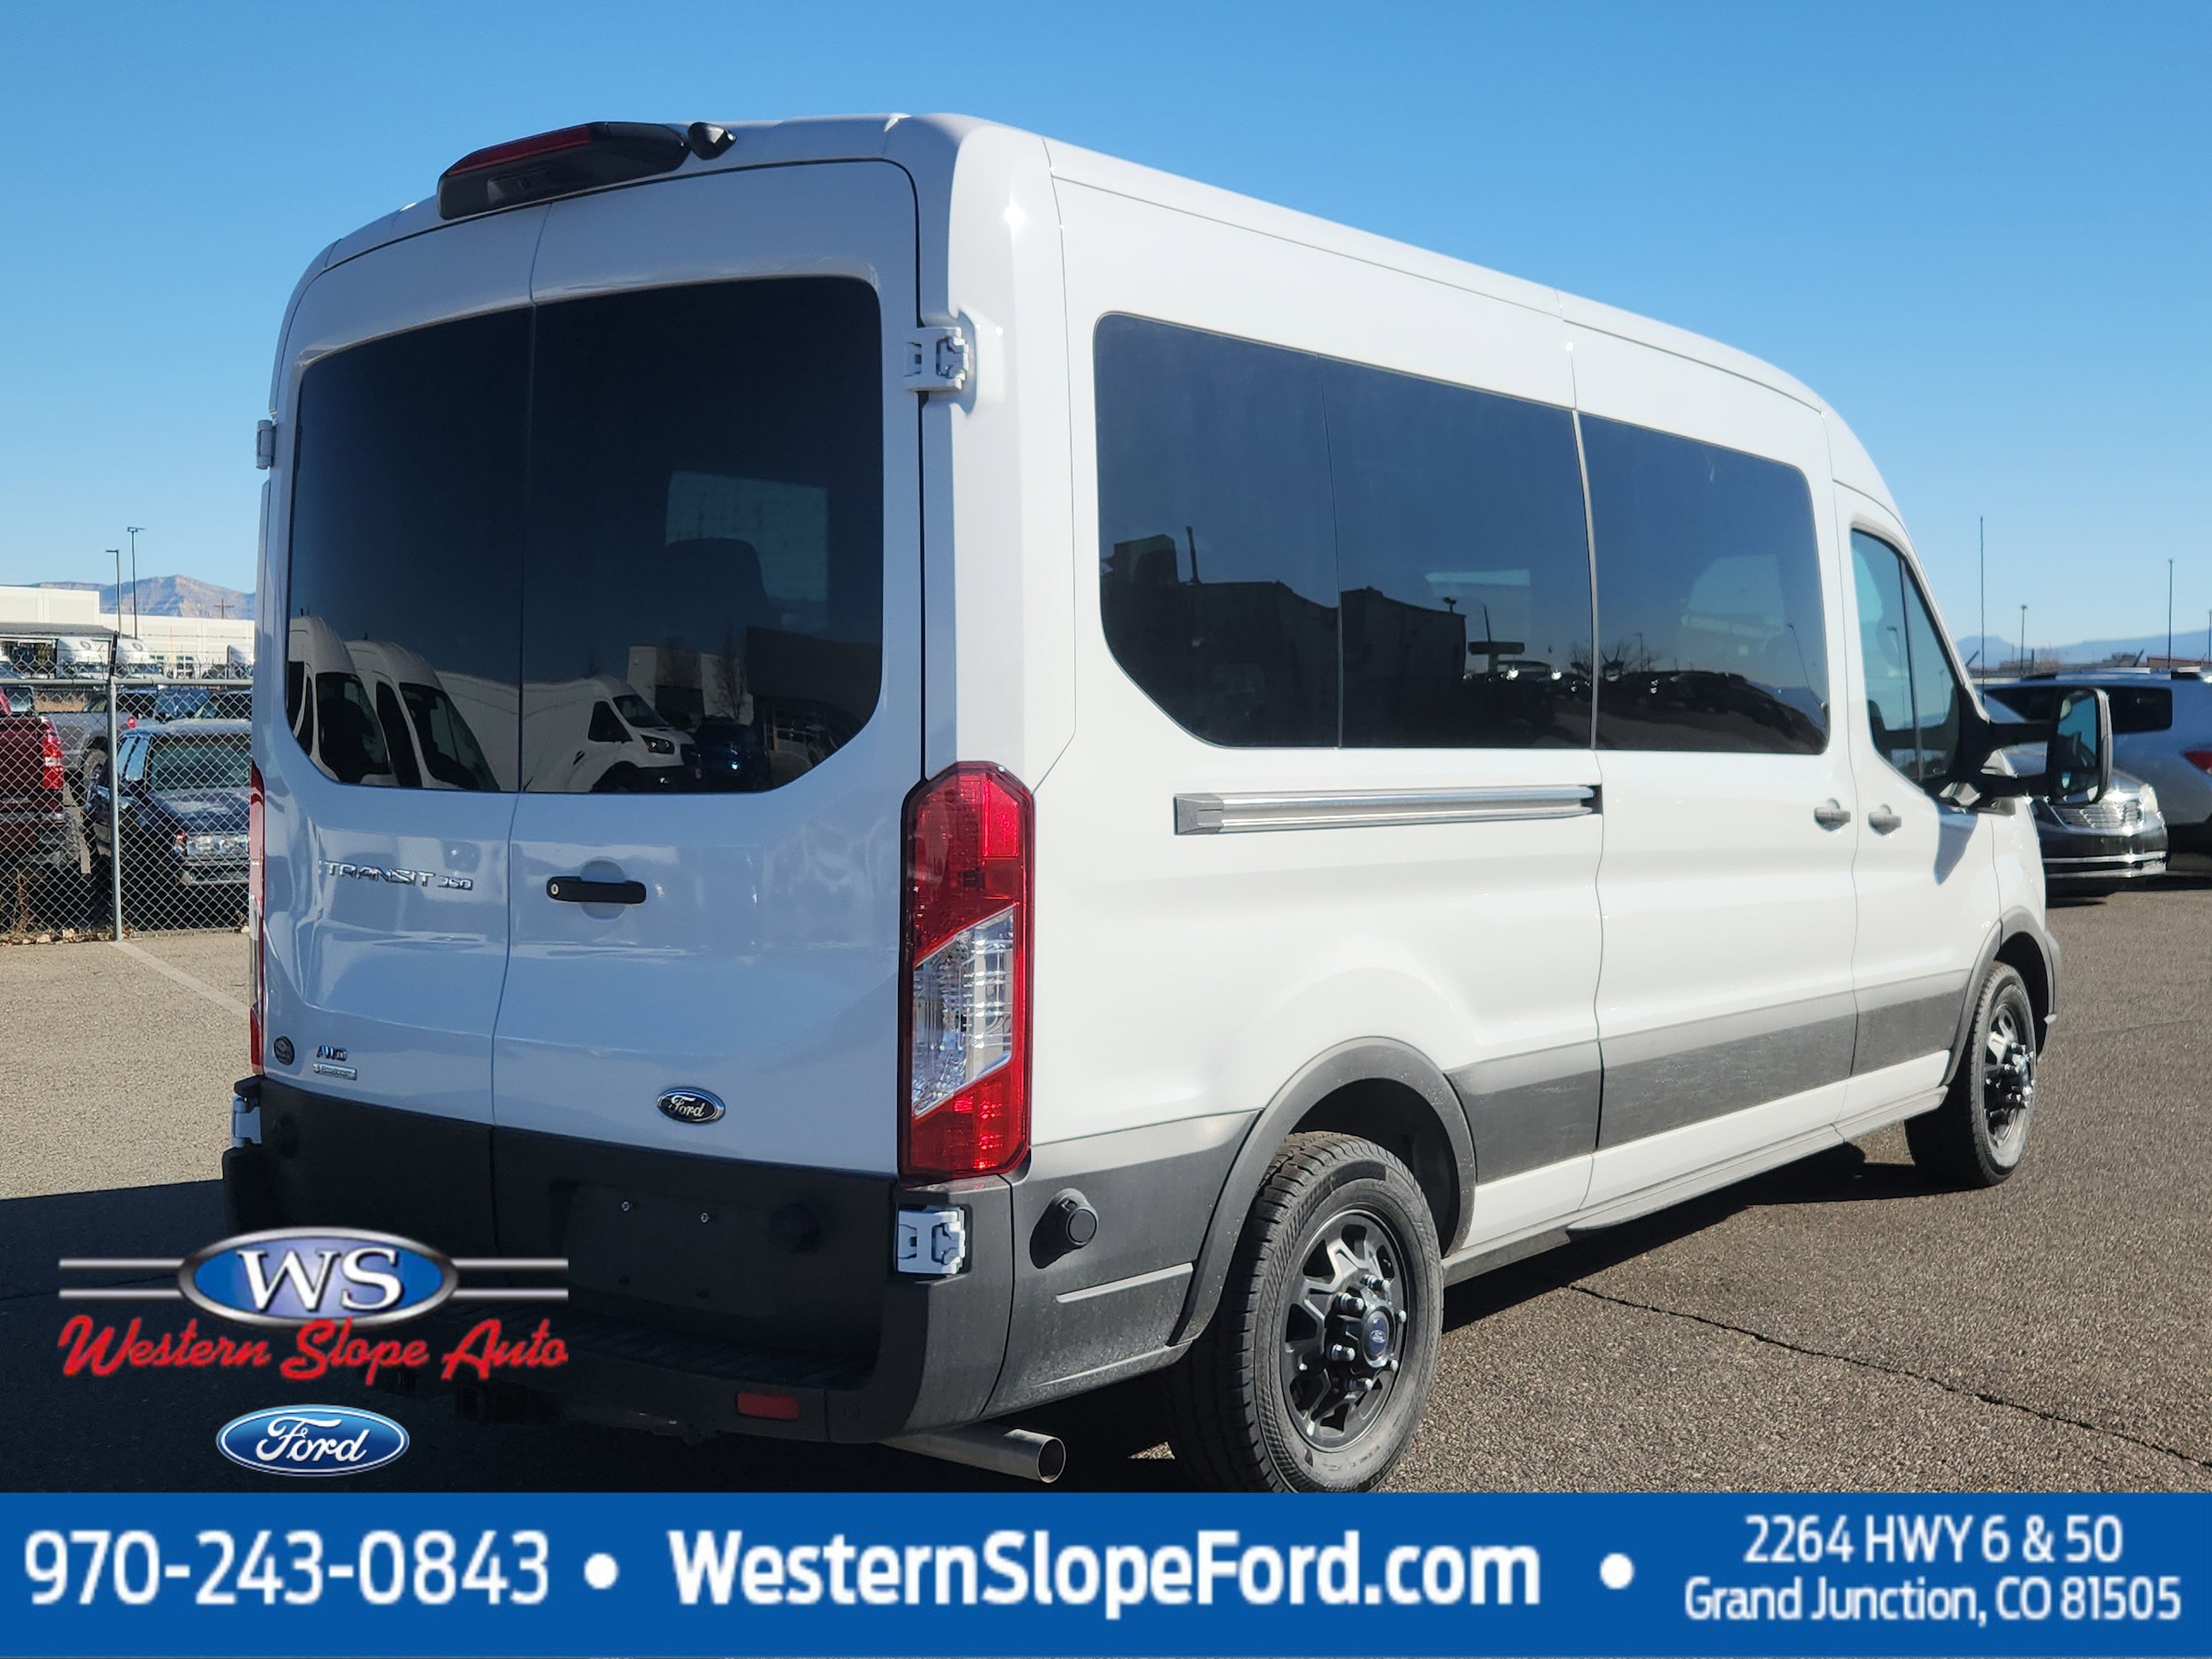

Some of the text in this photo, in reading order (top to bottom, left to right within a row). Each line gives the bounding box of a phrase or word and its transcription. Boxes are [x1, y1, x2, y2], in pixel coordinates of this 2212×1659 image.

[324, 860, 474, 891] TRANSIT 350
[668, 1094, 706, 1118] Ford
